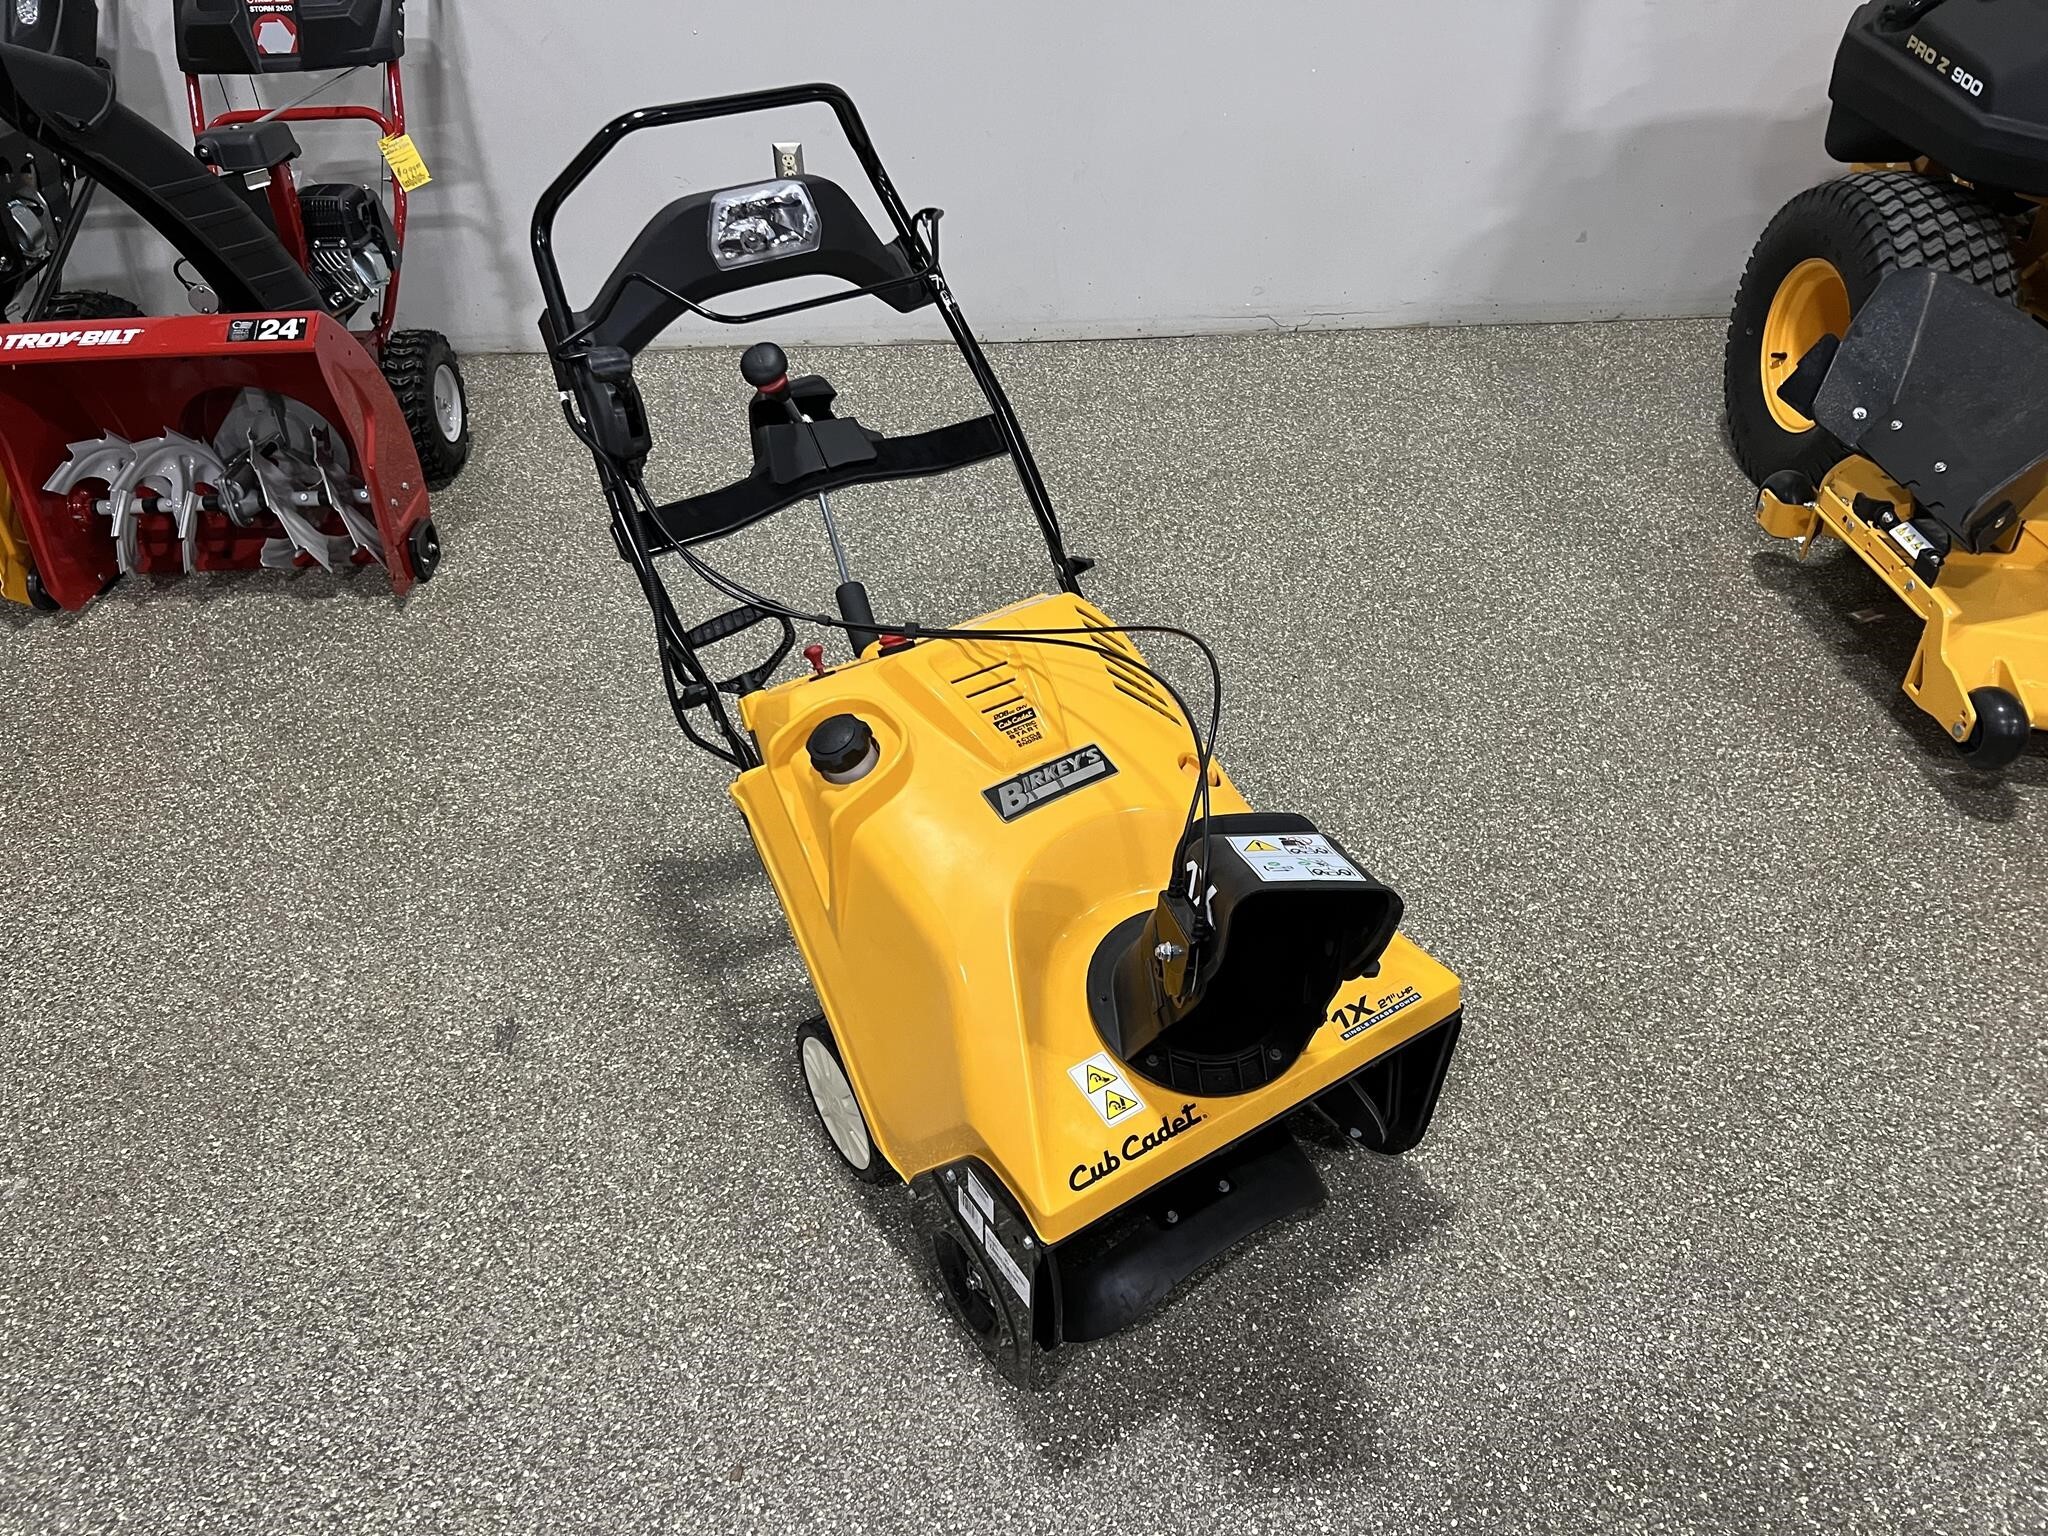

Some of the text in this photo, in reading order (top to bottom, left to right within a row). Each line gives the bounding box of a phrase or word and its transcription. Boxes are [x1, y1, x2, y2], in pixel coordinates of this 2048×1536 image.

[1906, 34, 1984, 97] PRO Z 900
[3, 329, 142, 350] TROY-BILT
[1006, 720, 1036, 735] ELECTRIC
[1009, 725, 1038, 740] START
[998, 748, 1101, 817] BIRKEY'S
[1331, 995, 1377, 1029] 1X
[1394, 994, 1420, 1010] POWER
[1069, 1103, 1203, 1191] Cub Cadet
